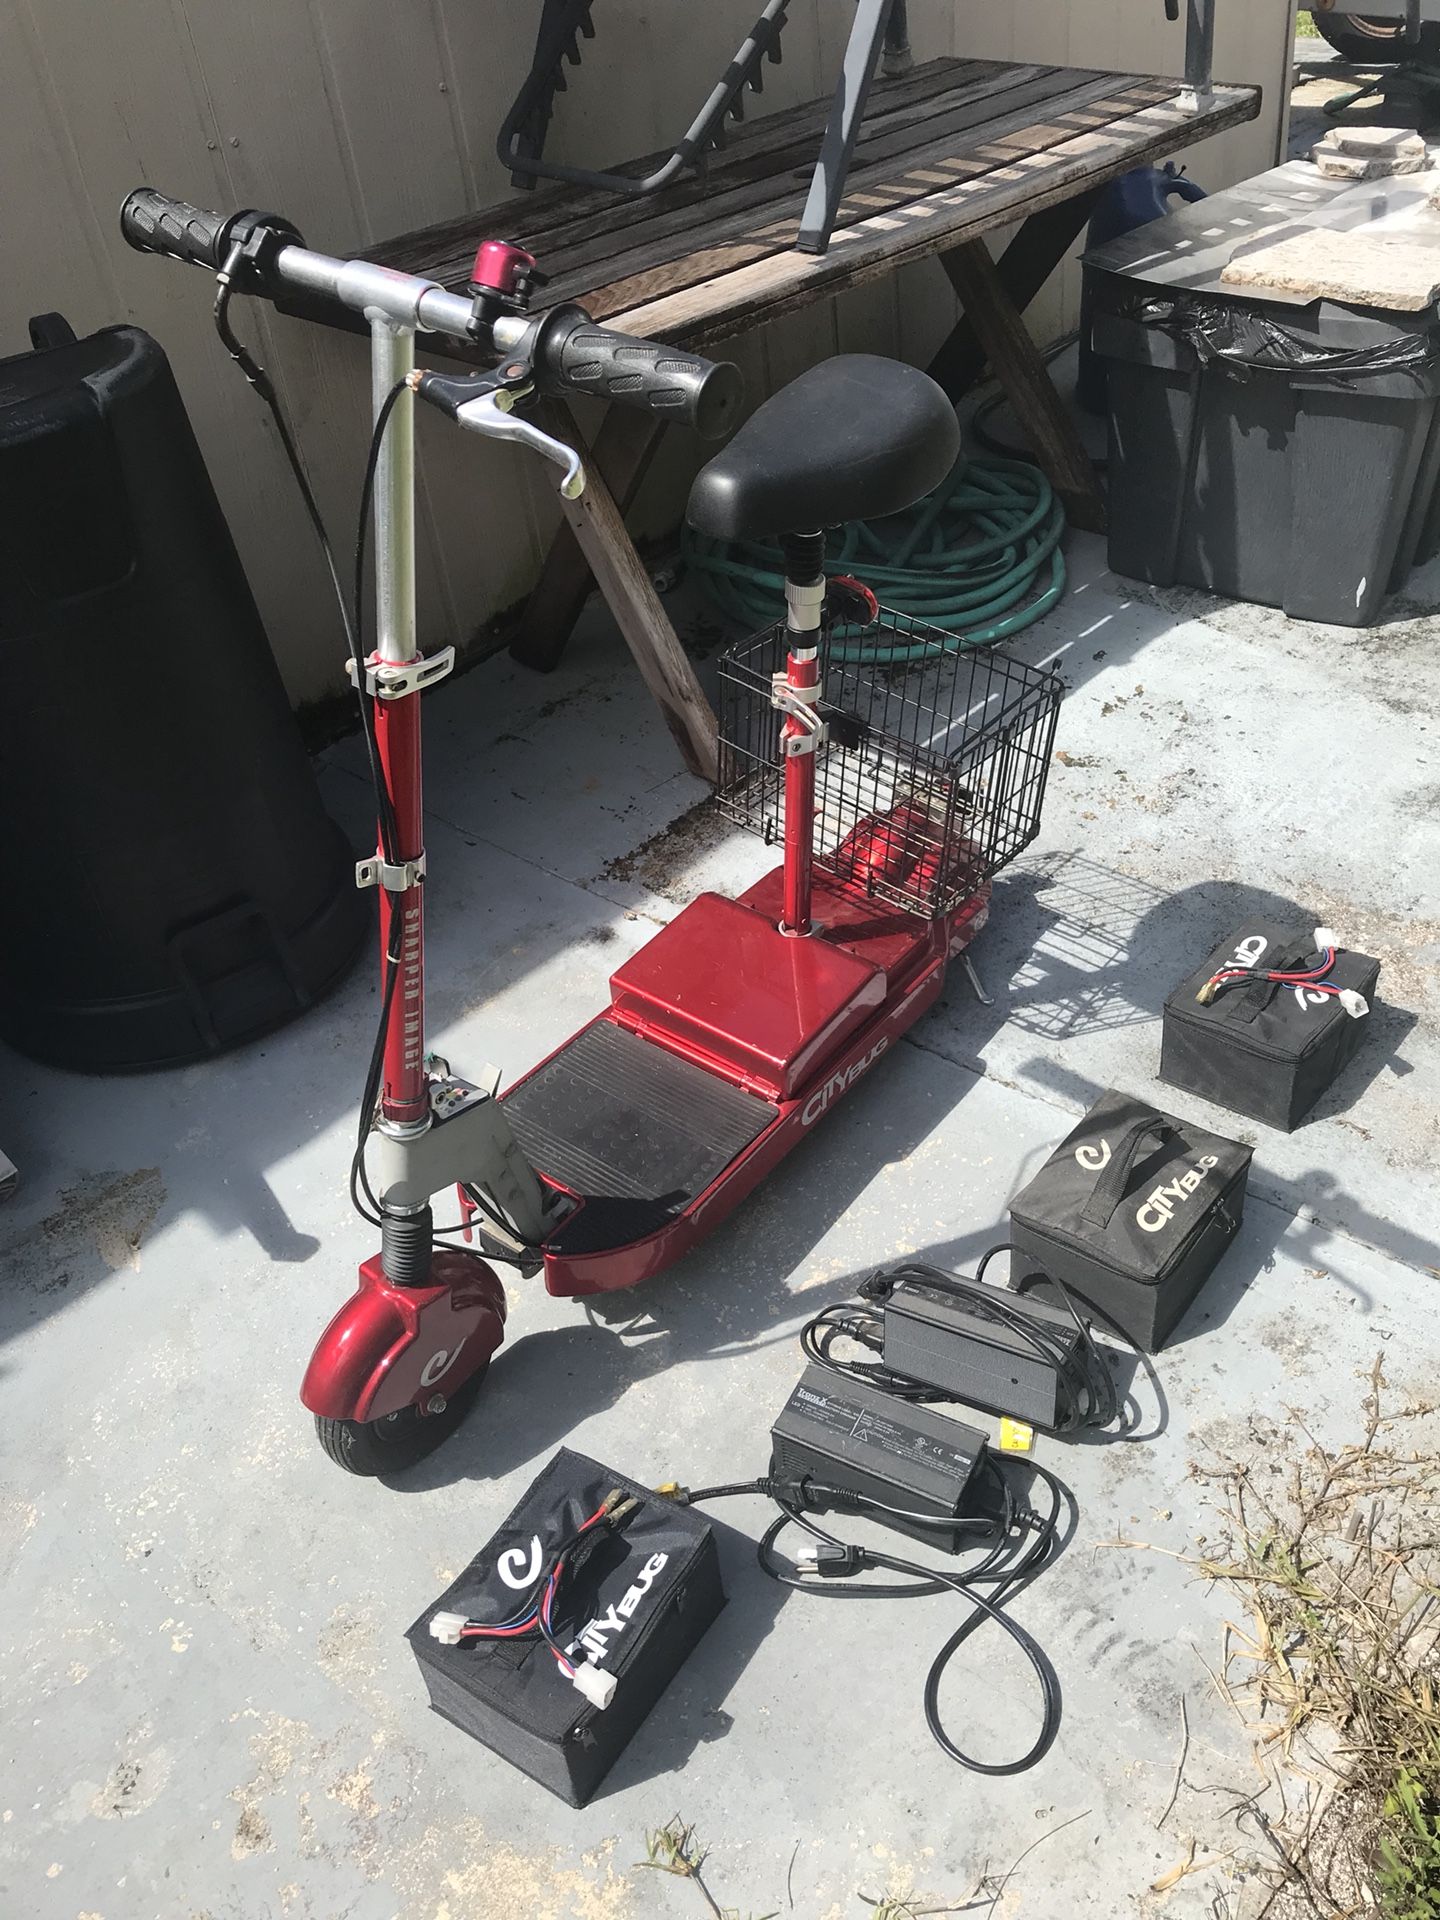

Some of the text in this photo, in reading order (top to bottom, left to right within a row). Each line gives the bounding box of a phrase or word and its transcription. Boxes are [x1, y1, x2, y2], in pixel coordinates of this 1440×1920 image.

[404, 908, 420, 1071] SHARPER IMAGE
[801, 1035, 889, 1126] CITYBUG
[1136, 1155, 1219, 1232] CITYBUG
